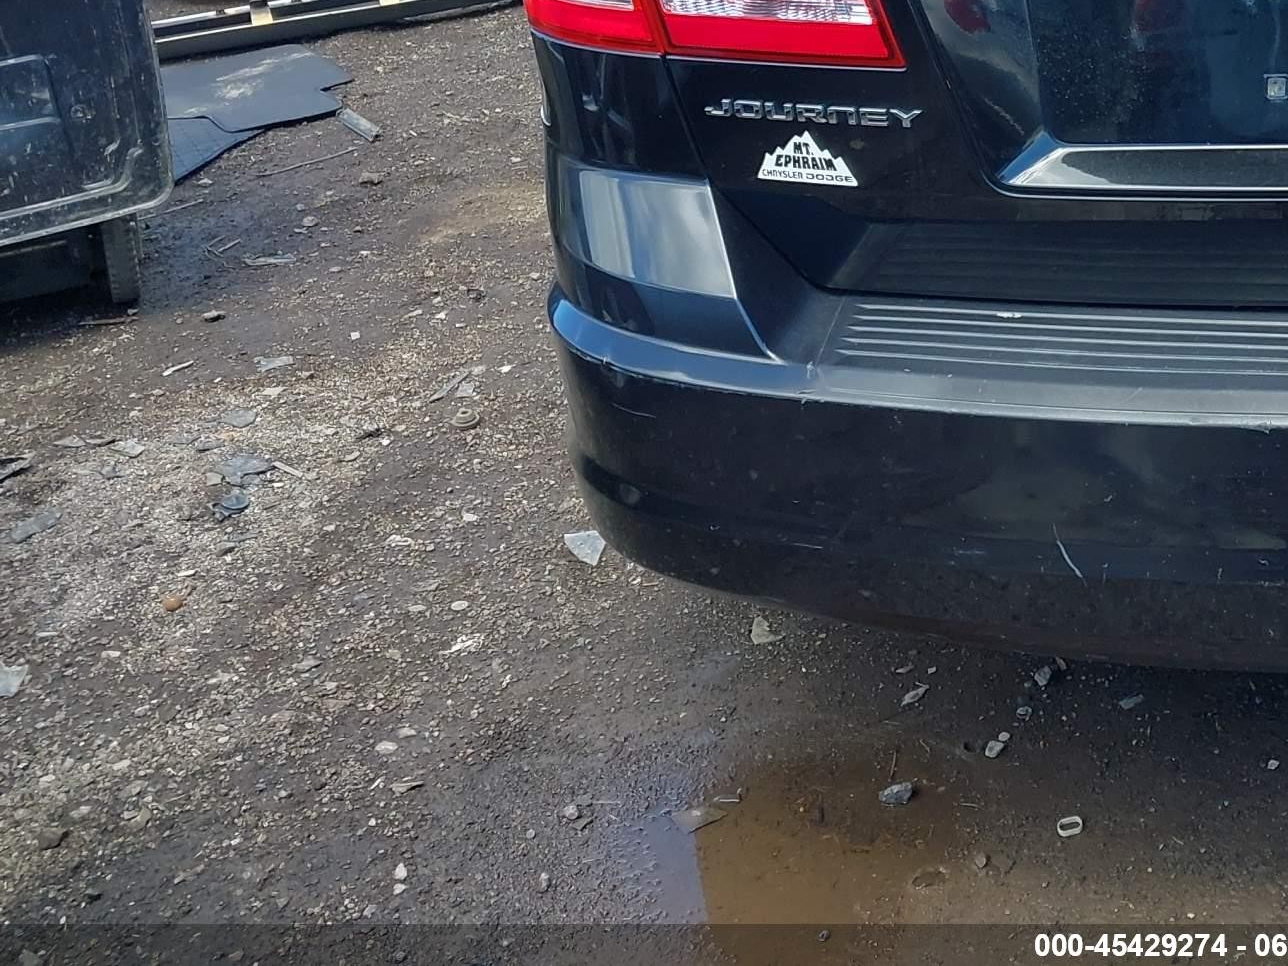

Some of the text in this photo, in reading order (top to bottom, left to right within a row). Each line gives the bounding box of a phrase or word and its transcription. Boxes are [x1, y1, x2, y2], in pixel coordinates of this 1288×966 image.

[704, 98, 923, 128] JOURNEY
[793, 141, 815, 156] MT.
[774, 154, 838, 172] EPHRAIM
[761, 168, 854, 183] CHRYSLER DODGE
